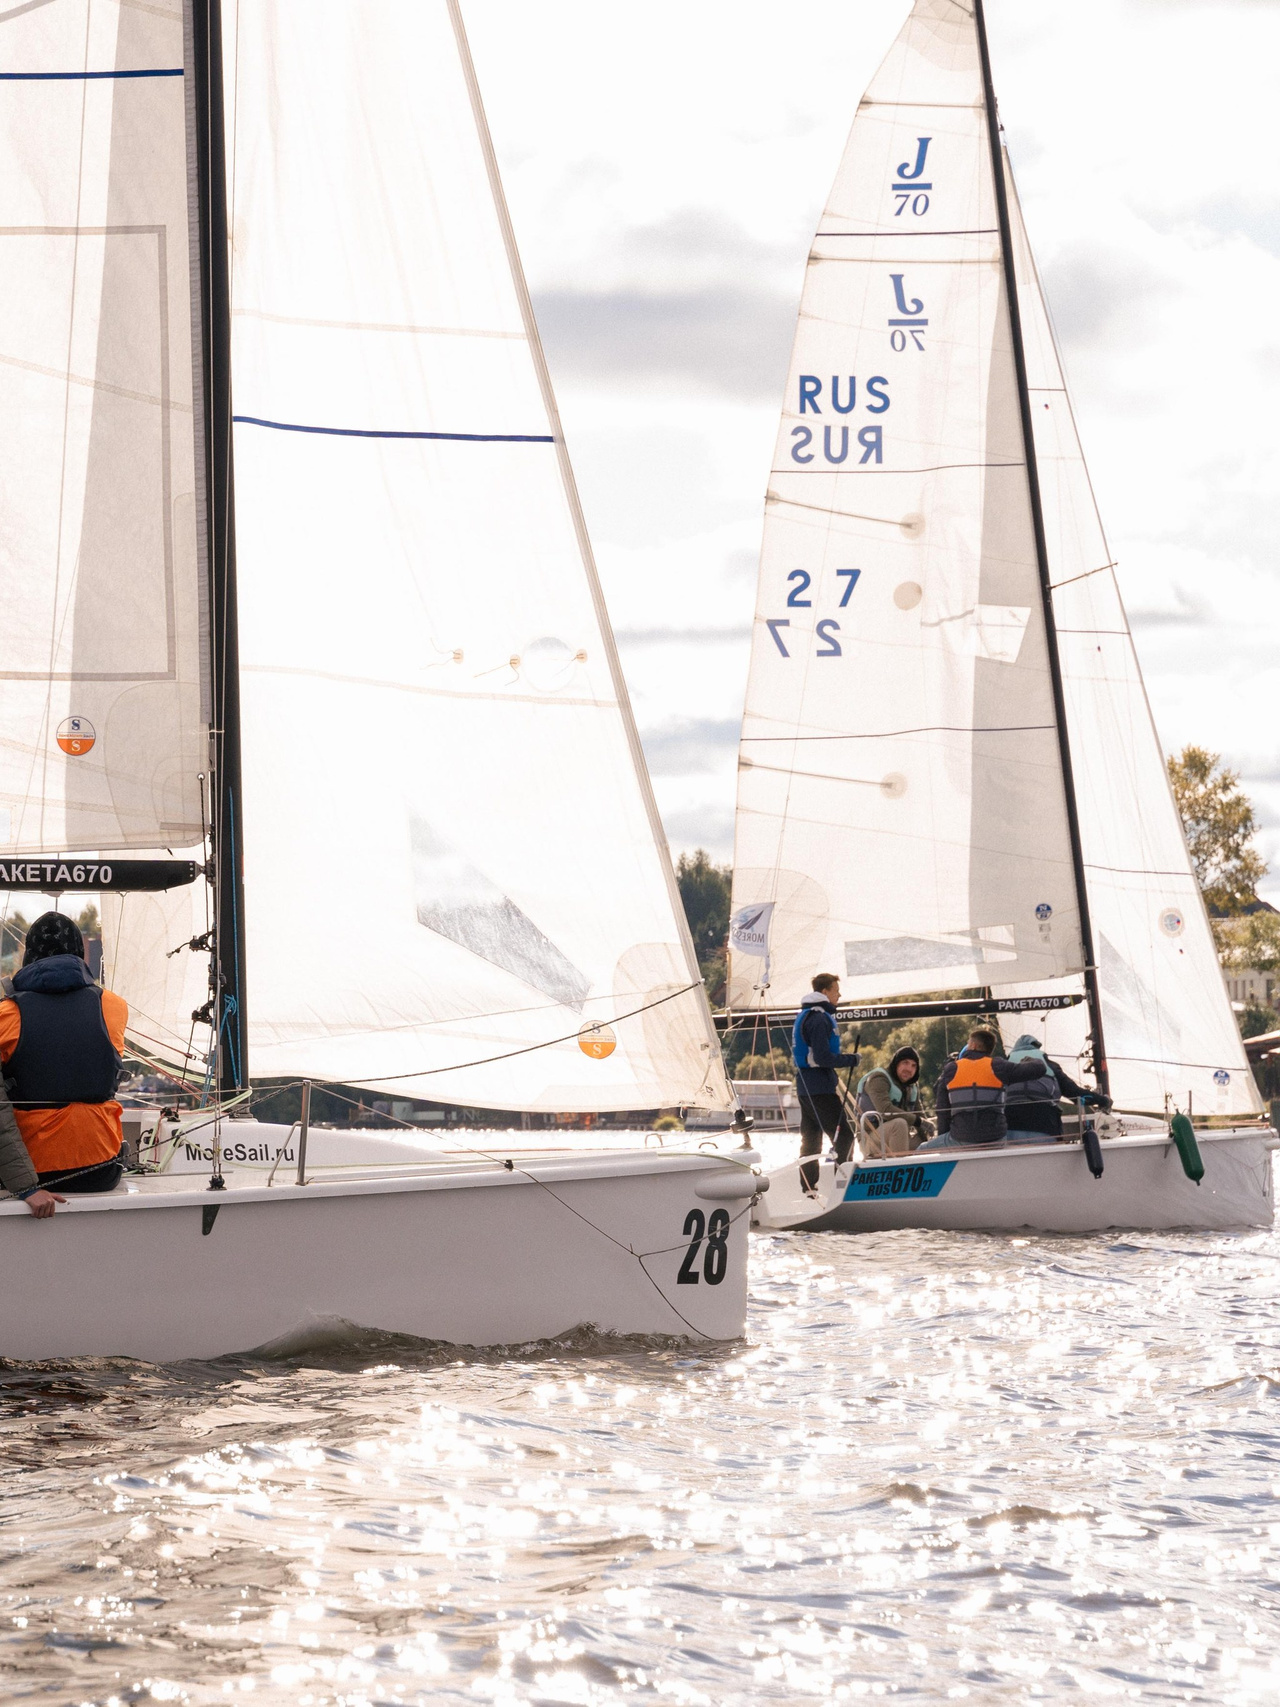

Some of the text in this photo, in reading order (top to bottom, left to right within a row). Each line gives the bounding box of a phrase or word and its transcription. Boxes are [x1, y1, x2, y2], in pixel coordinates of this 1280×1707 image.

[896, 136, 933, 180] J
[894, 193, 930, 217] 70
[798, 374, 891, 415] RUS
[786, 568, 862, 608] 27
[185, 1143, 295, 1162] MoeSail.ru
[867, 1183, 890, 1197] RUS
[890, 1166, 925, 1194] 670
[677, 1208, 730, 1286] 28
